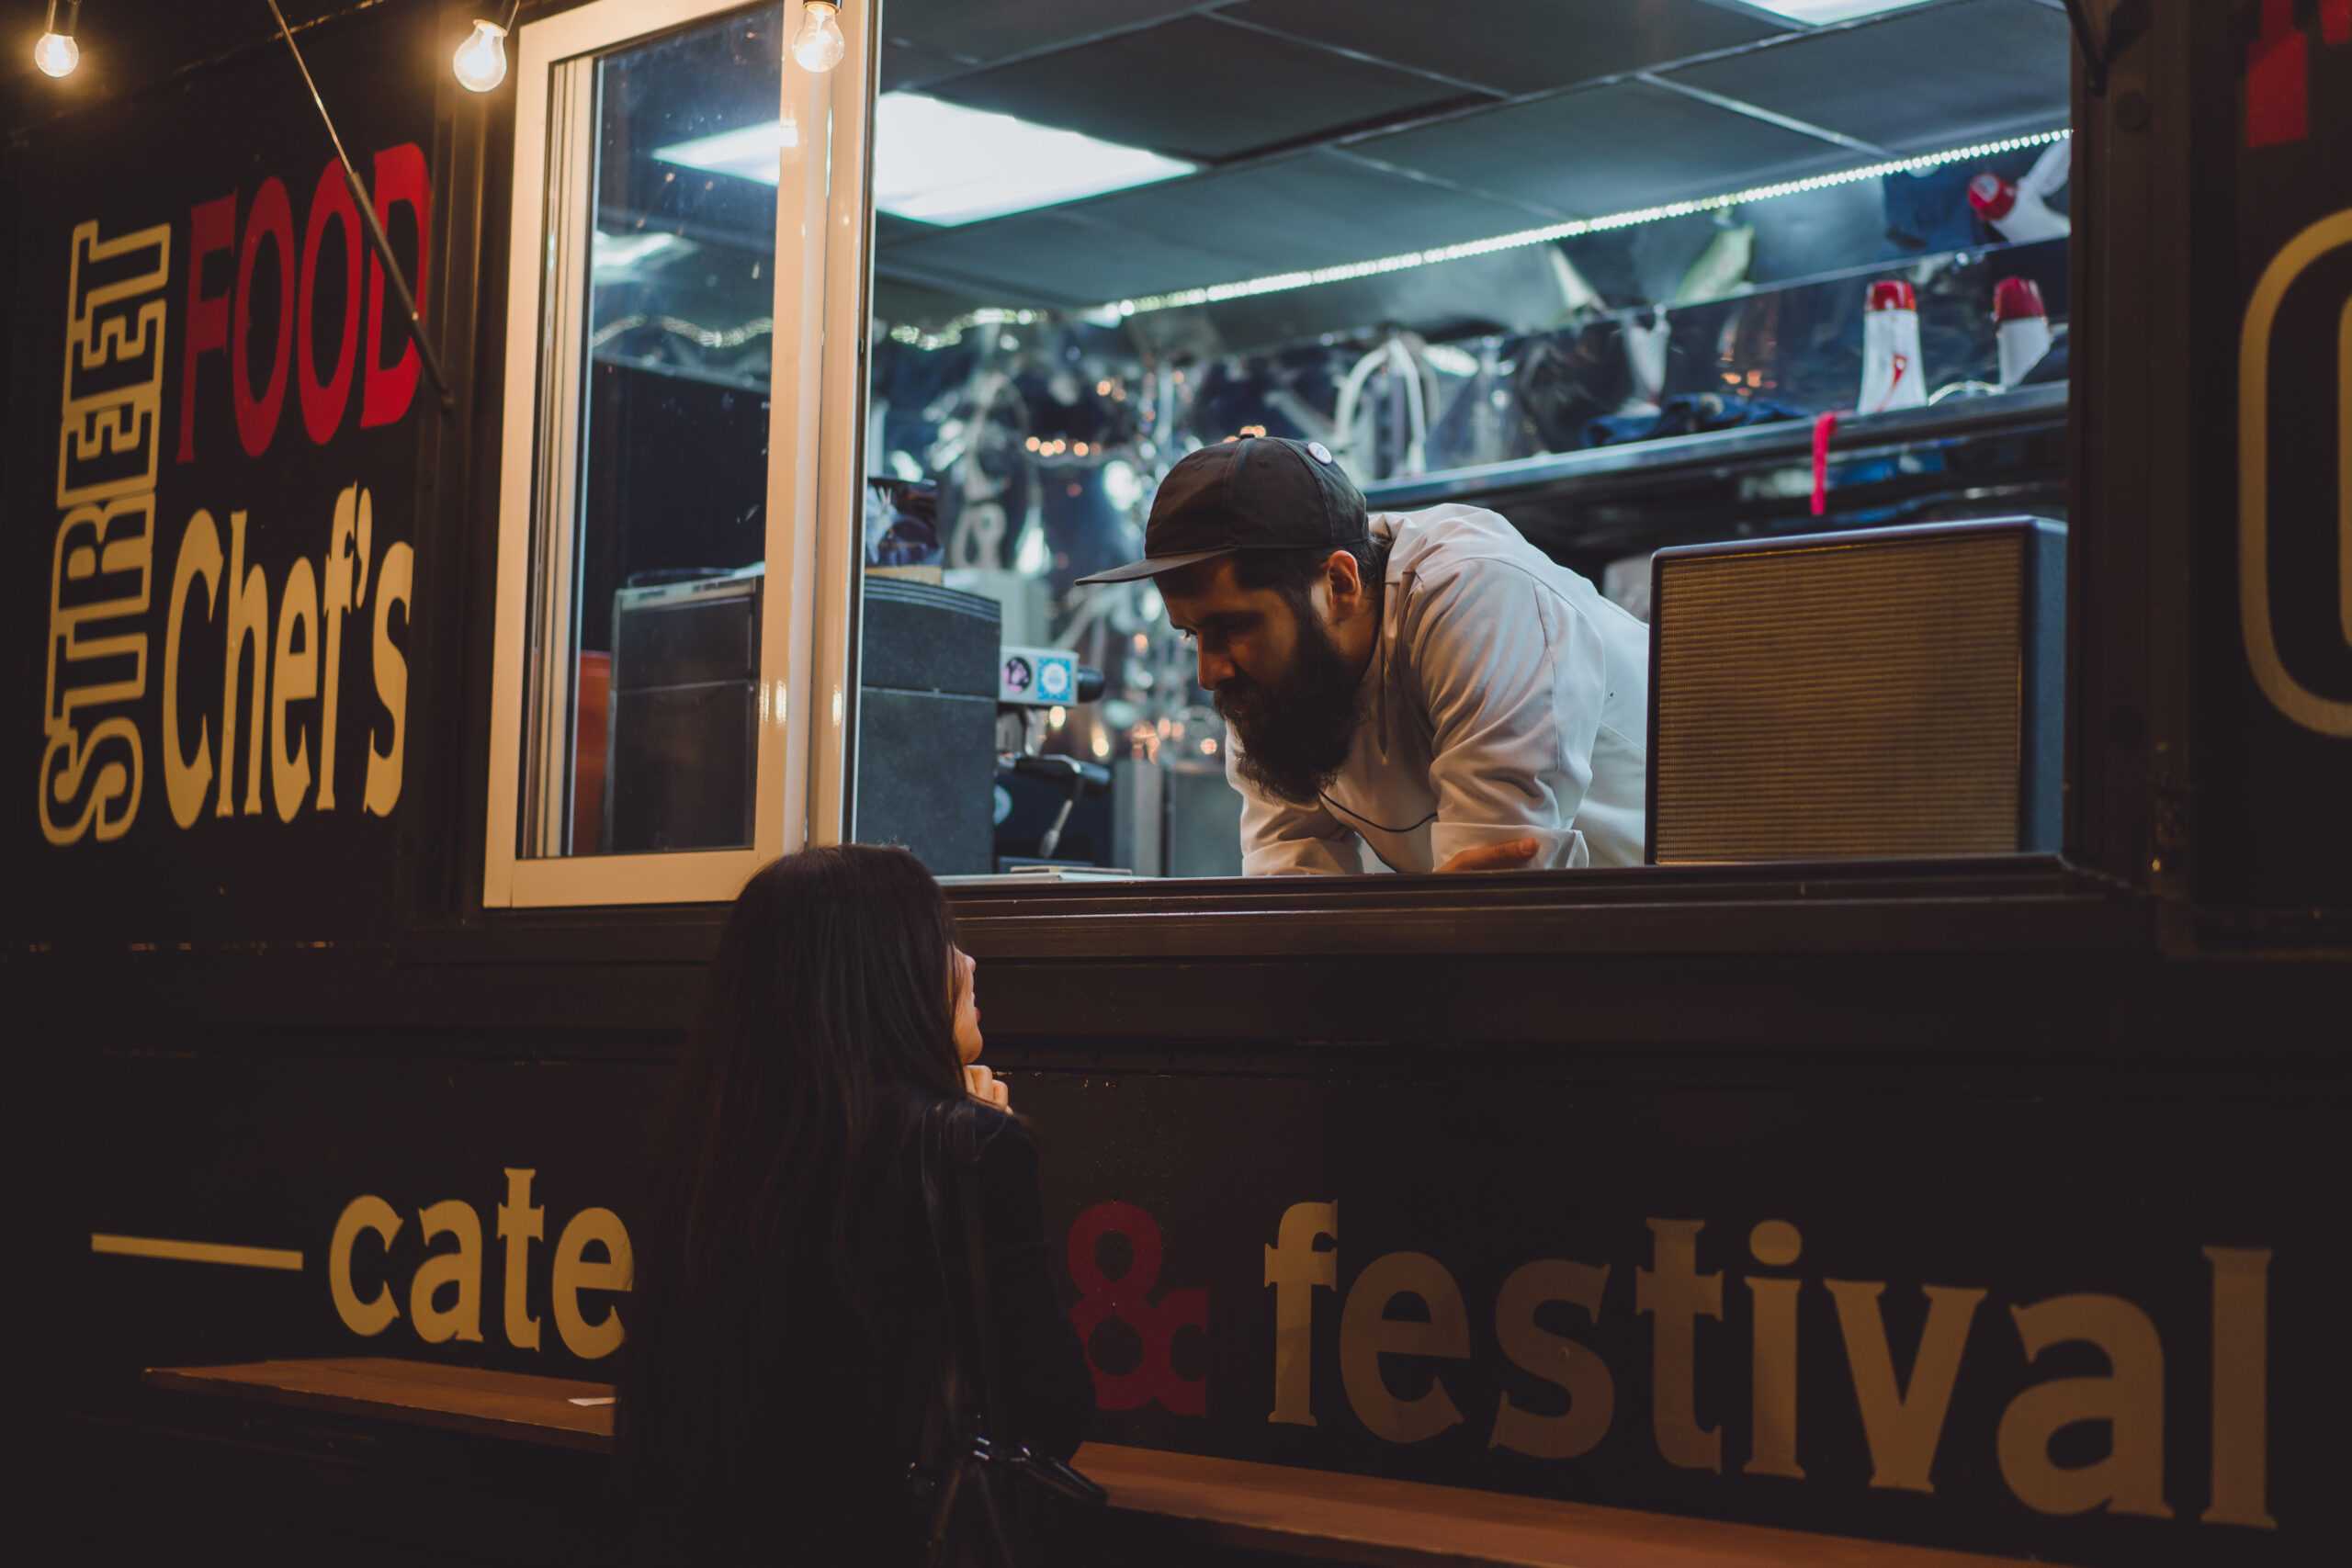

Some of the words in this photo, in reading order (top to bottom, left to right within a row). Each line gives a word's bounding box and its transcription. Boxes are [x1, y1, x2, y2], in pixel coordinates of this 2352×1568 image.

[176, 142, 432, 463] FOOD
[40, 220, 171, 845] STREET
[163, 480, 413, 829] Chef's
[1068, 1200, 1209, 1418] &
[1264, 1198, 2277, 1529] festival
